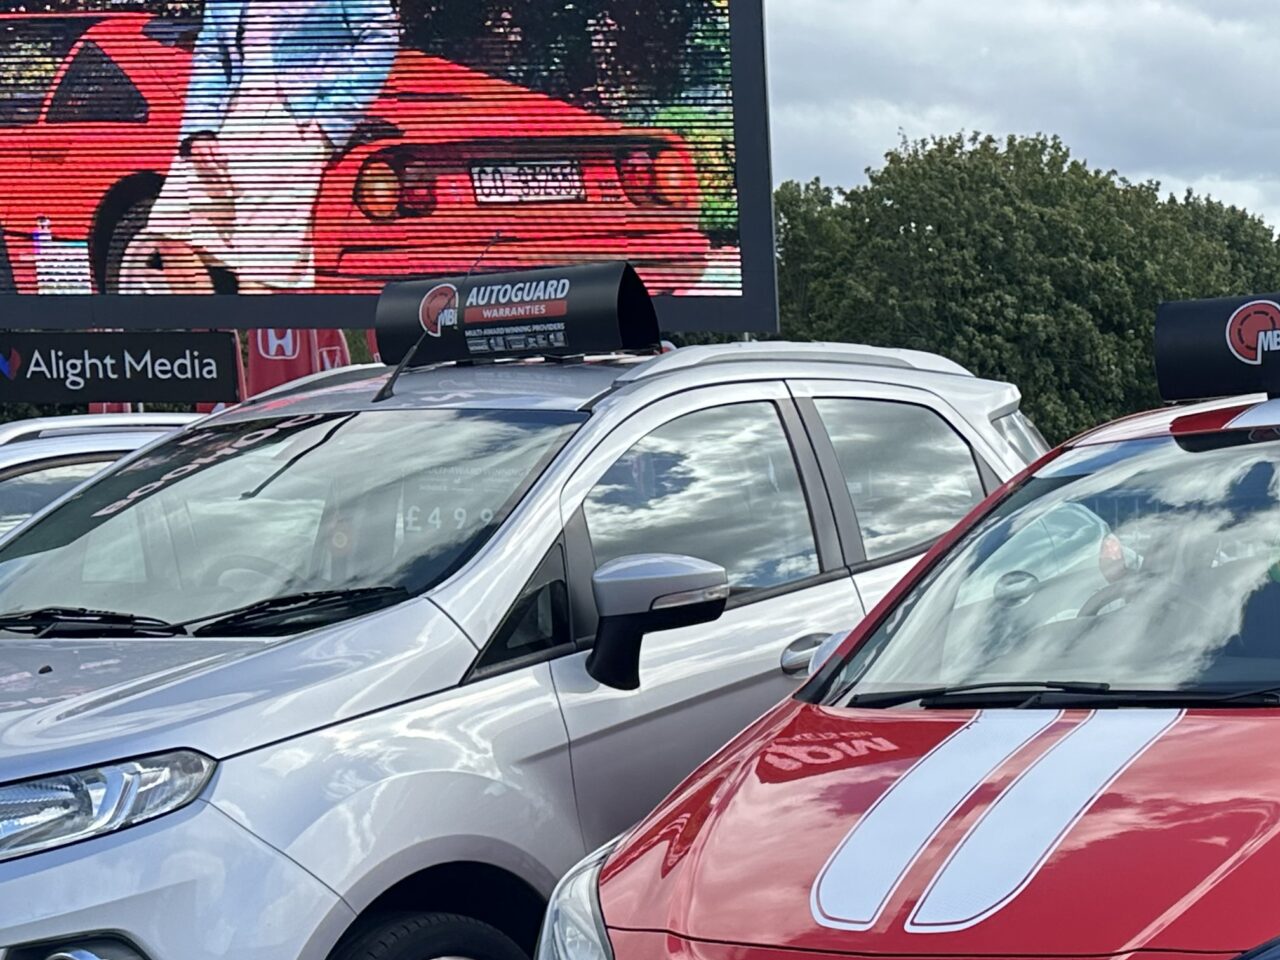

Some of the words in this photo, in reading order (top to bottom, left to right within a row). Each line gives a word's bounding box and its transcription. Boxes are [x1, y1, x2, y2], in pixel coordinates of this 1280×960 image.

[466, 279, 570, 307] AUTOGUARD
[482, 304, 546, 318] WARRANTIES
[26, 349, 118, 391] Alight
[124, 349, 218, 381] Media
